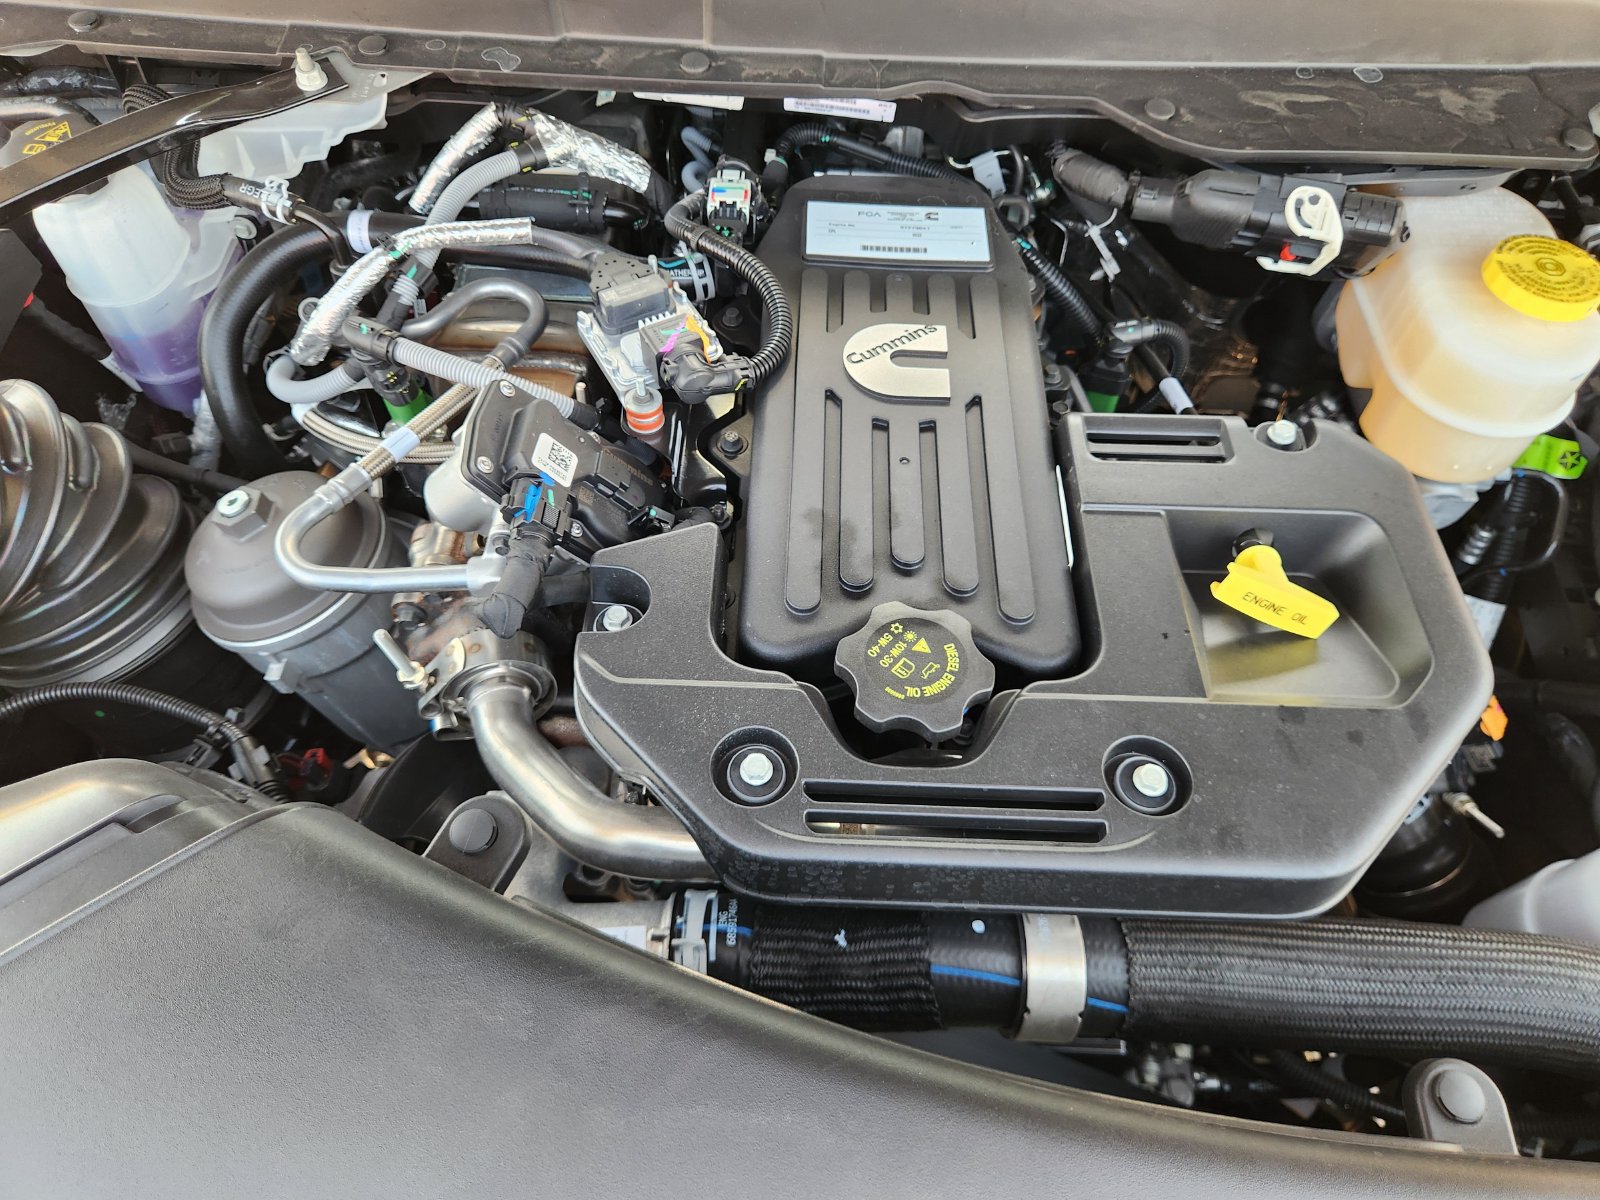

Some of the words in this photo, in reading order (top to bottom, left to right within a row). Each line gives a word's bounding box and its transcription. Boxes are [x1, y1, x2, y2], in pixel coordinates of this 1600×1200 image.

[239, 182, 261, 199] EGR
[846, 324, 938, 365] Cummins
[1242, 591, 1287, 616] ENGINE
[1291, 612, 1308, 625] OIL
[867, 632, 894, 658] 5W-40
[879, 641, 908, 668] 10W-30
[943, 642, 960, 672] DIESEL
[904, 685, 921, 698] OIL
[921, 672, 956, 697] ENGINE
